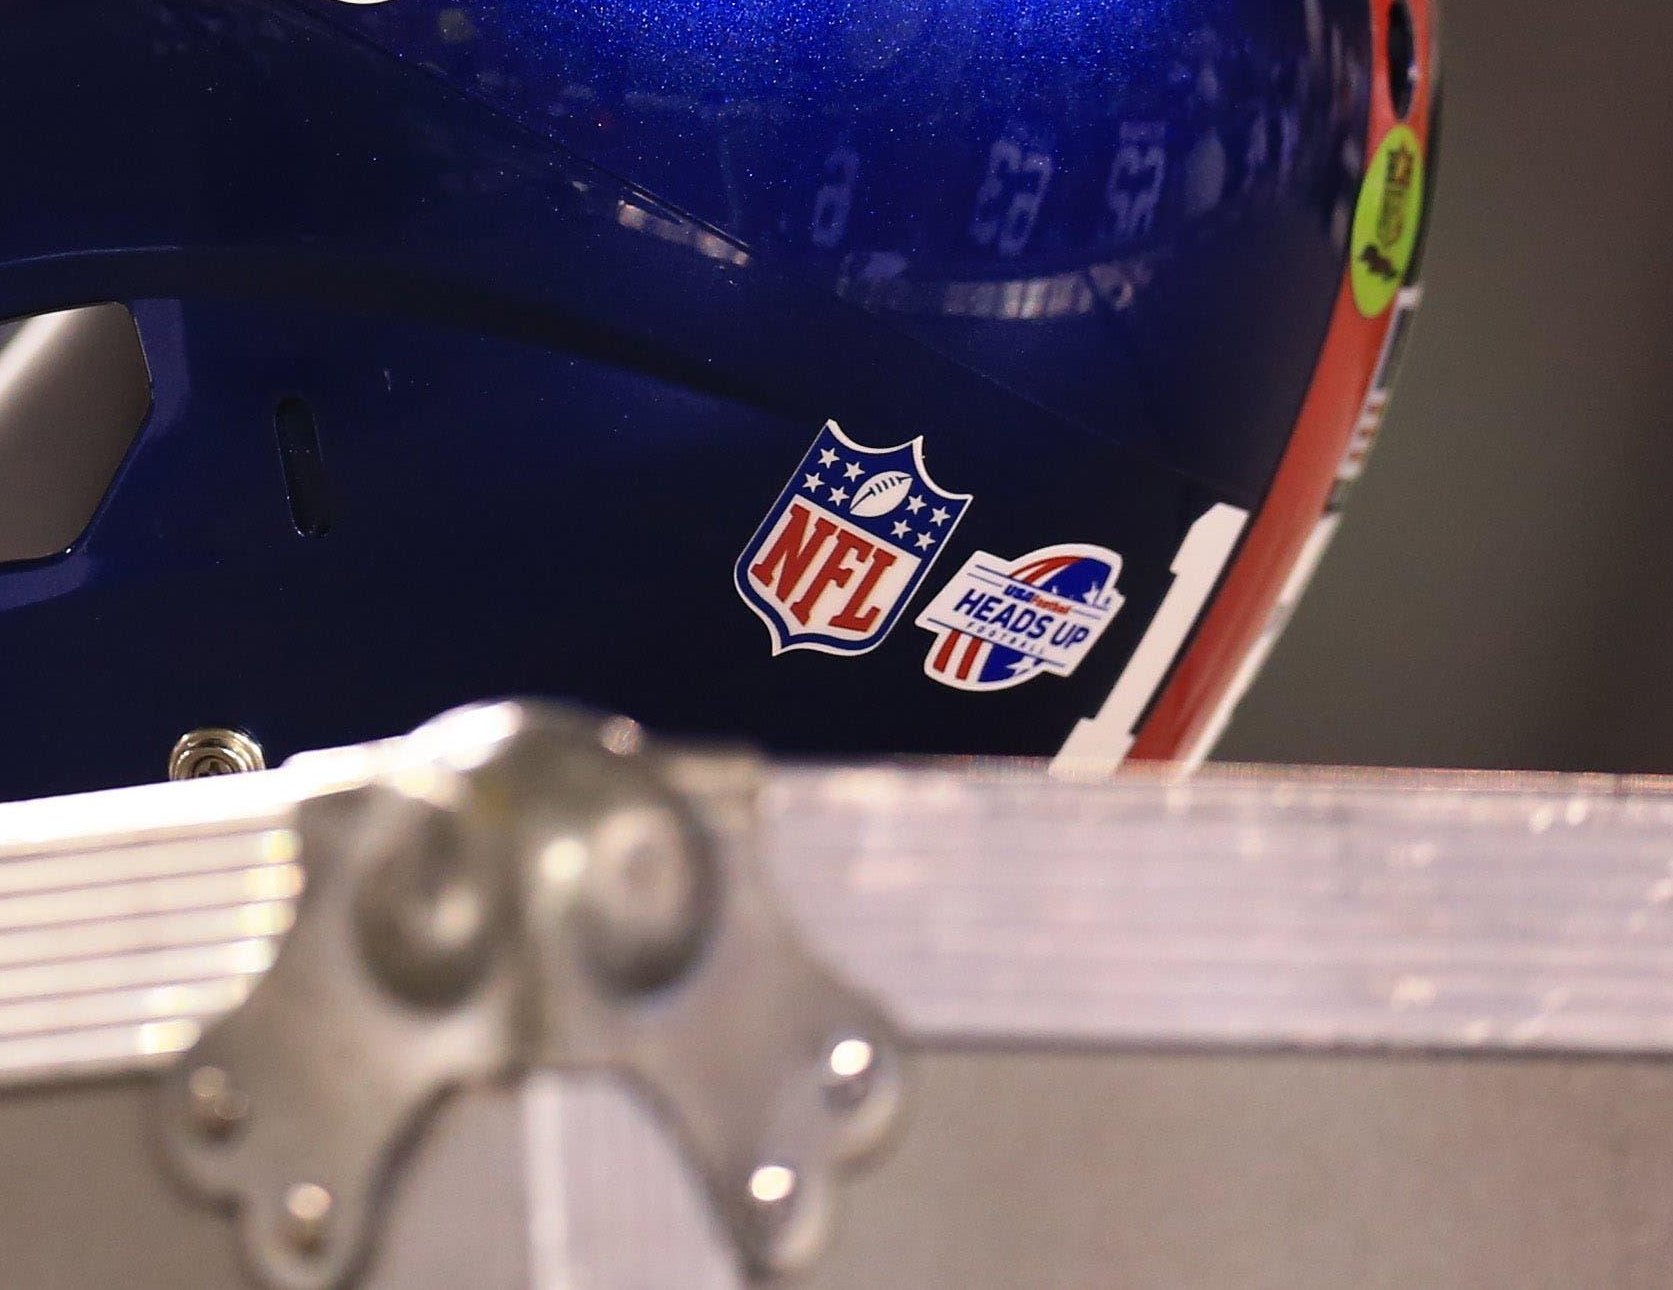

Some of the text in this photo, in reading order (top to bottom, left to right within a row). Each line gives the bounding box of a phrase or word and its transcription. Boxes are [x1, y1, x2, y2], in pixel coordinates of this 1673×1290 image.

[749, 503, 899, 634] NFL
[953, 588, 1090, 649] HEADS UP
